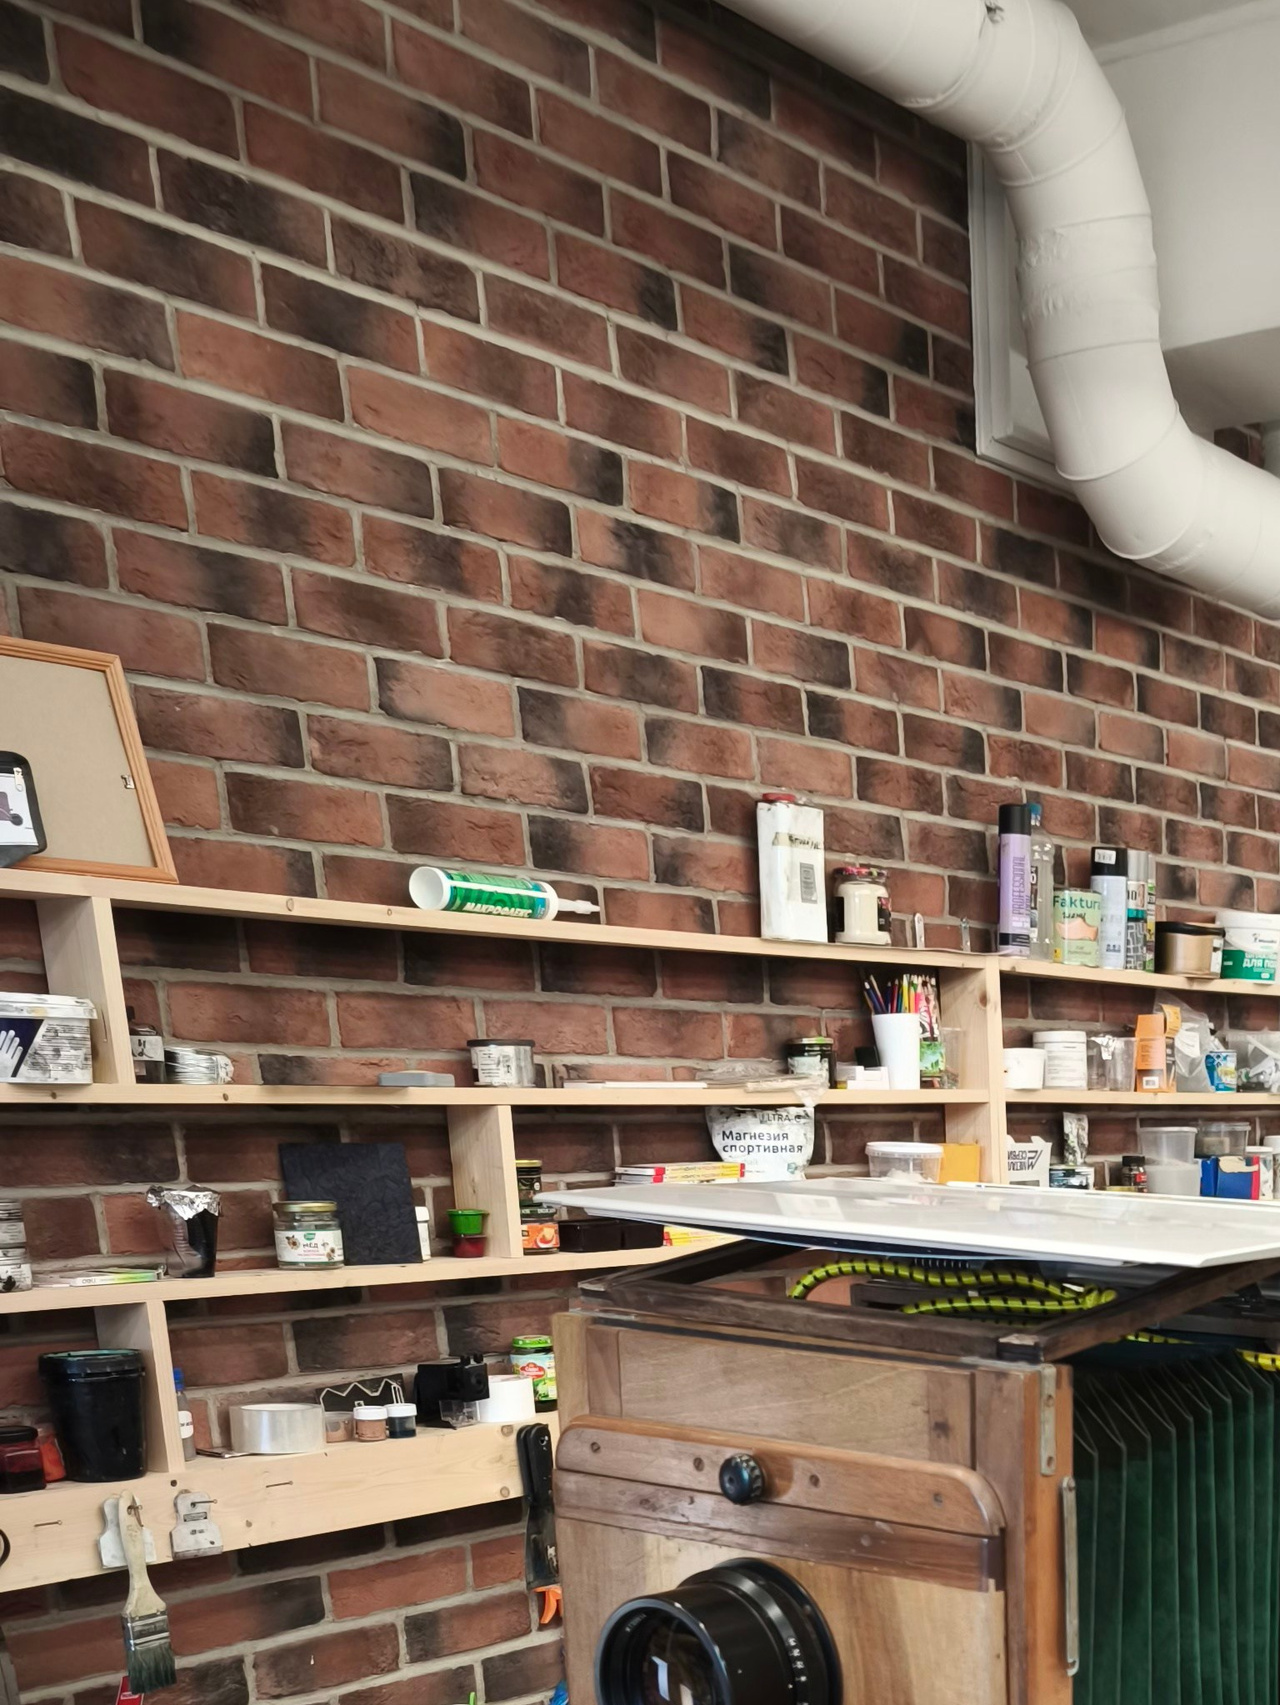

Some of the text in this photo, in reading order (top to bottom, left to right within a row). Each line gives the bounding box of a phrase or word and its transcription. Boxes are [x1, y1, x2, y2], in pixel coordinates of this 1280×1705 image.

[462, 902, 533, 918] МАКРОФЛЕКС
[721, 1130, 789, 1142] Магнезия
[722, 1144, 804, 1156] спортивная
